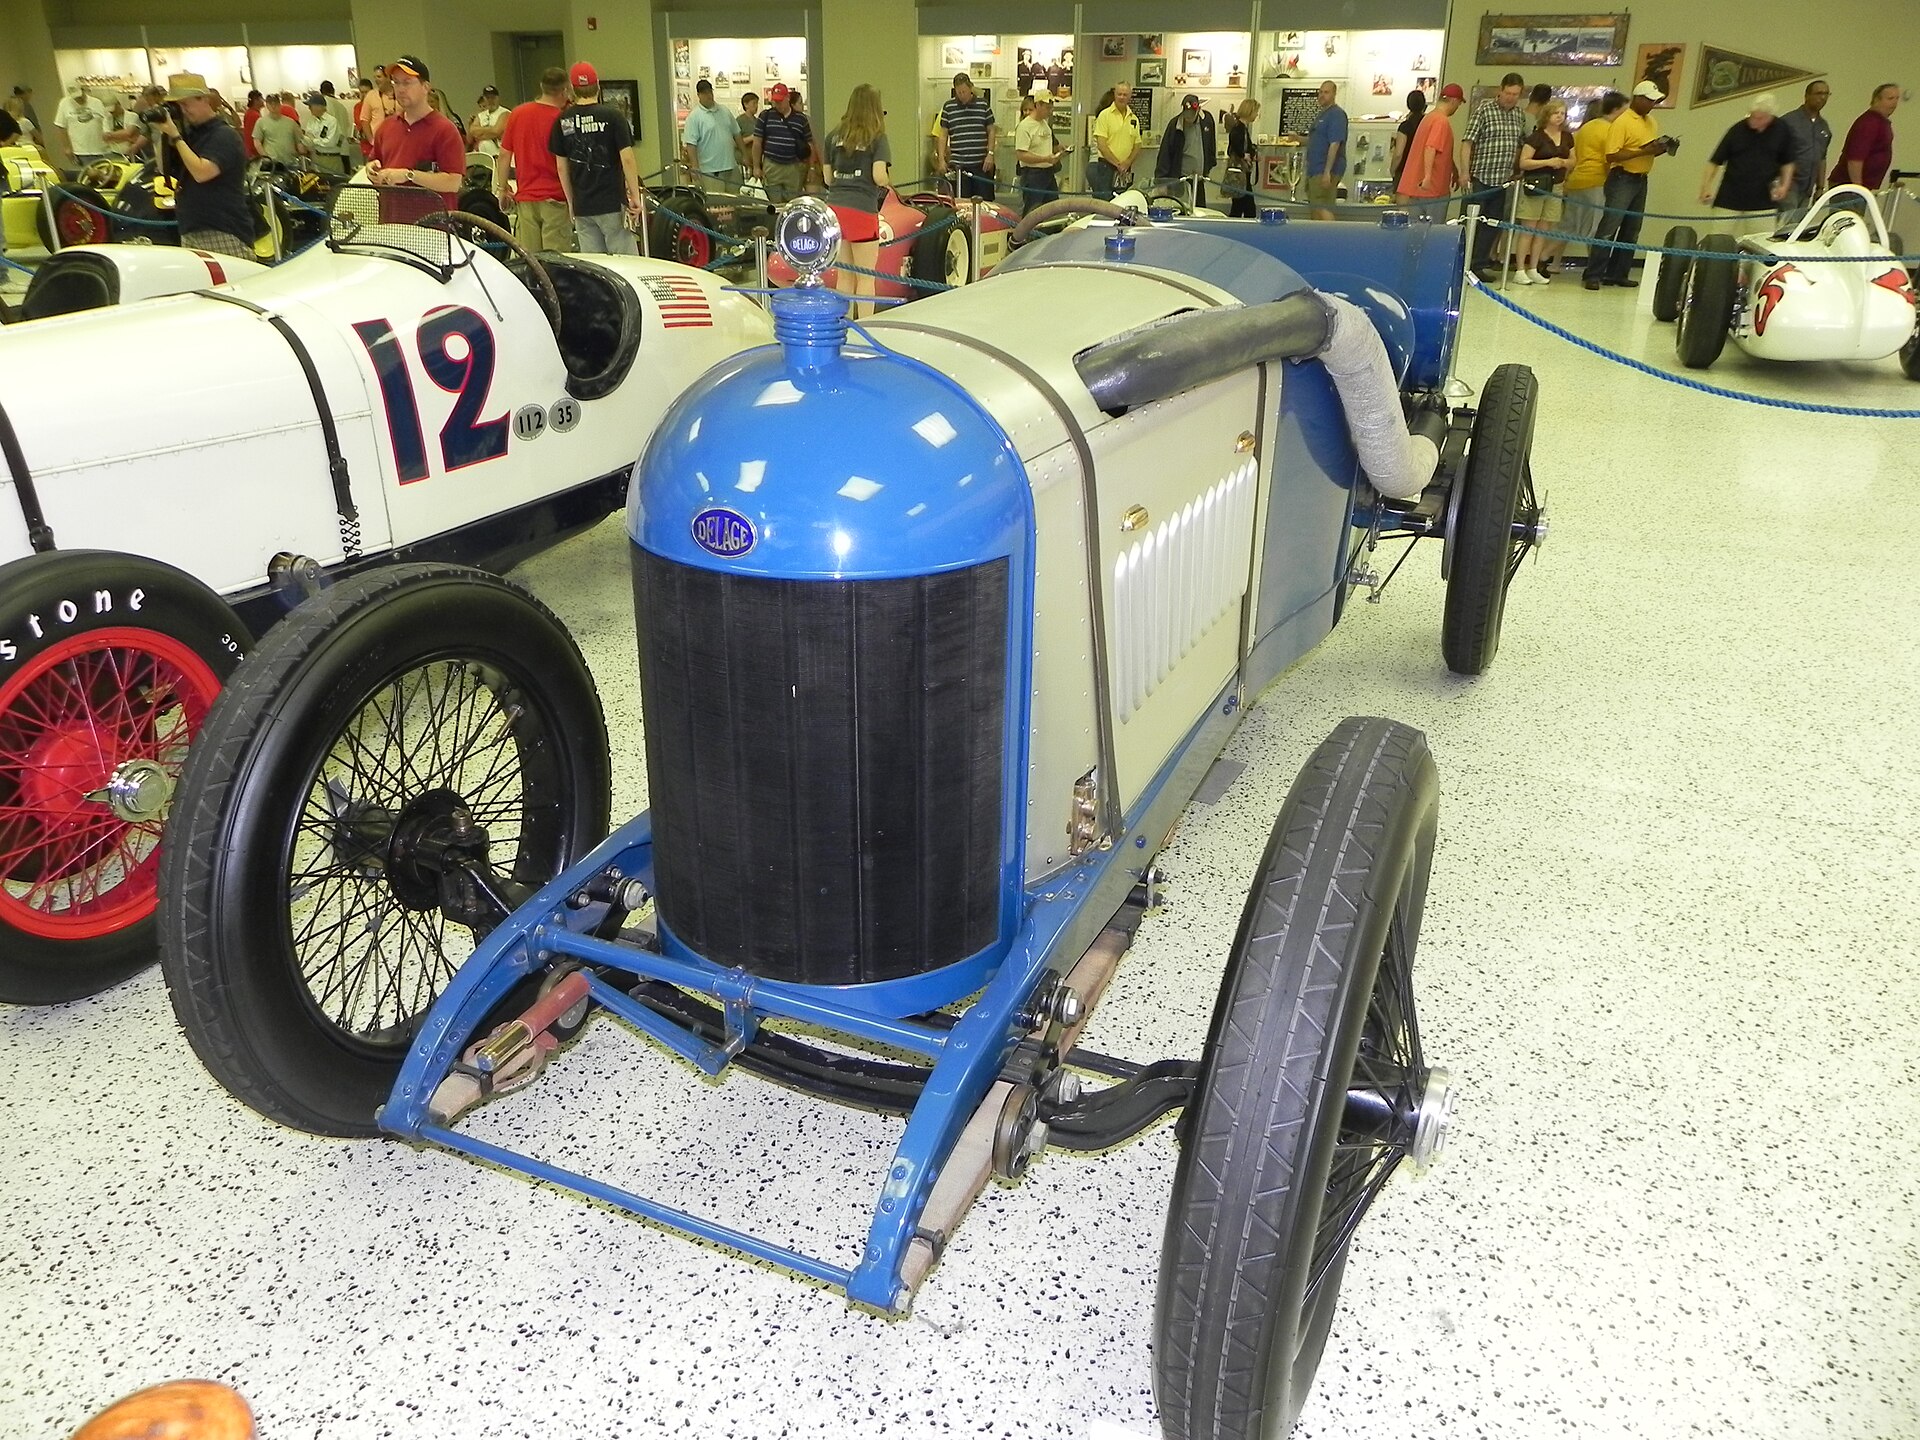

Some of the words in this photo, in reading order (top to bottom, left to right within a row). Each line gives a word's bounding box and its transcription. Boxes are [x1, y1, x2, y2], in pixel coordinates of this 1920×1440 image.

[581, 122, 605, 133] INDY
[792, 238, 816, 251] DELAGE
[351, 304, 511, 486] 12
[519, 411, 543, 433] 112
[557, 405, 573, 425] 35
[697, 516, 749, 551] DELAGE
[221, 633, 238, 652] 30
